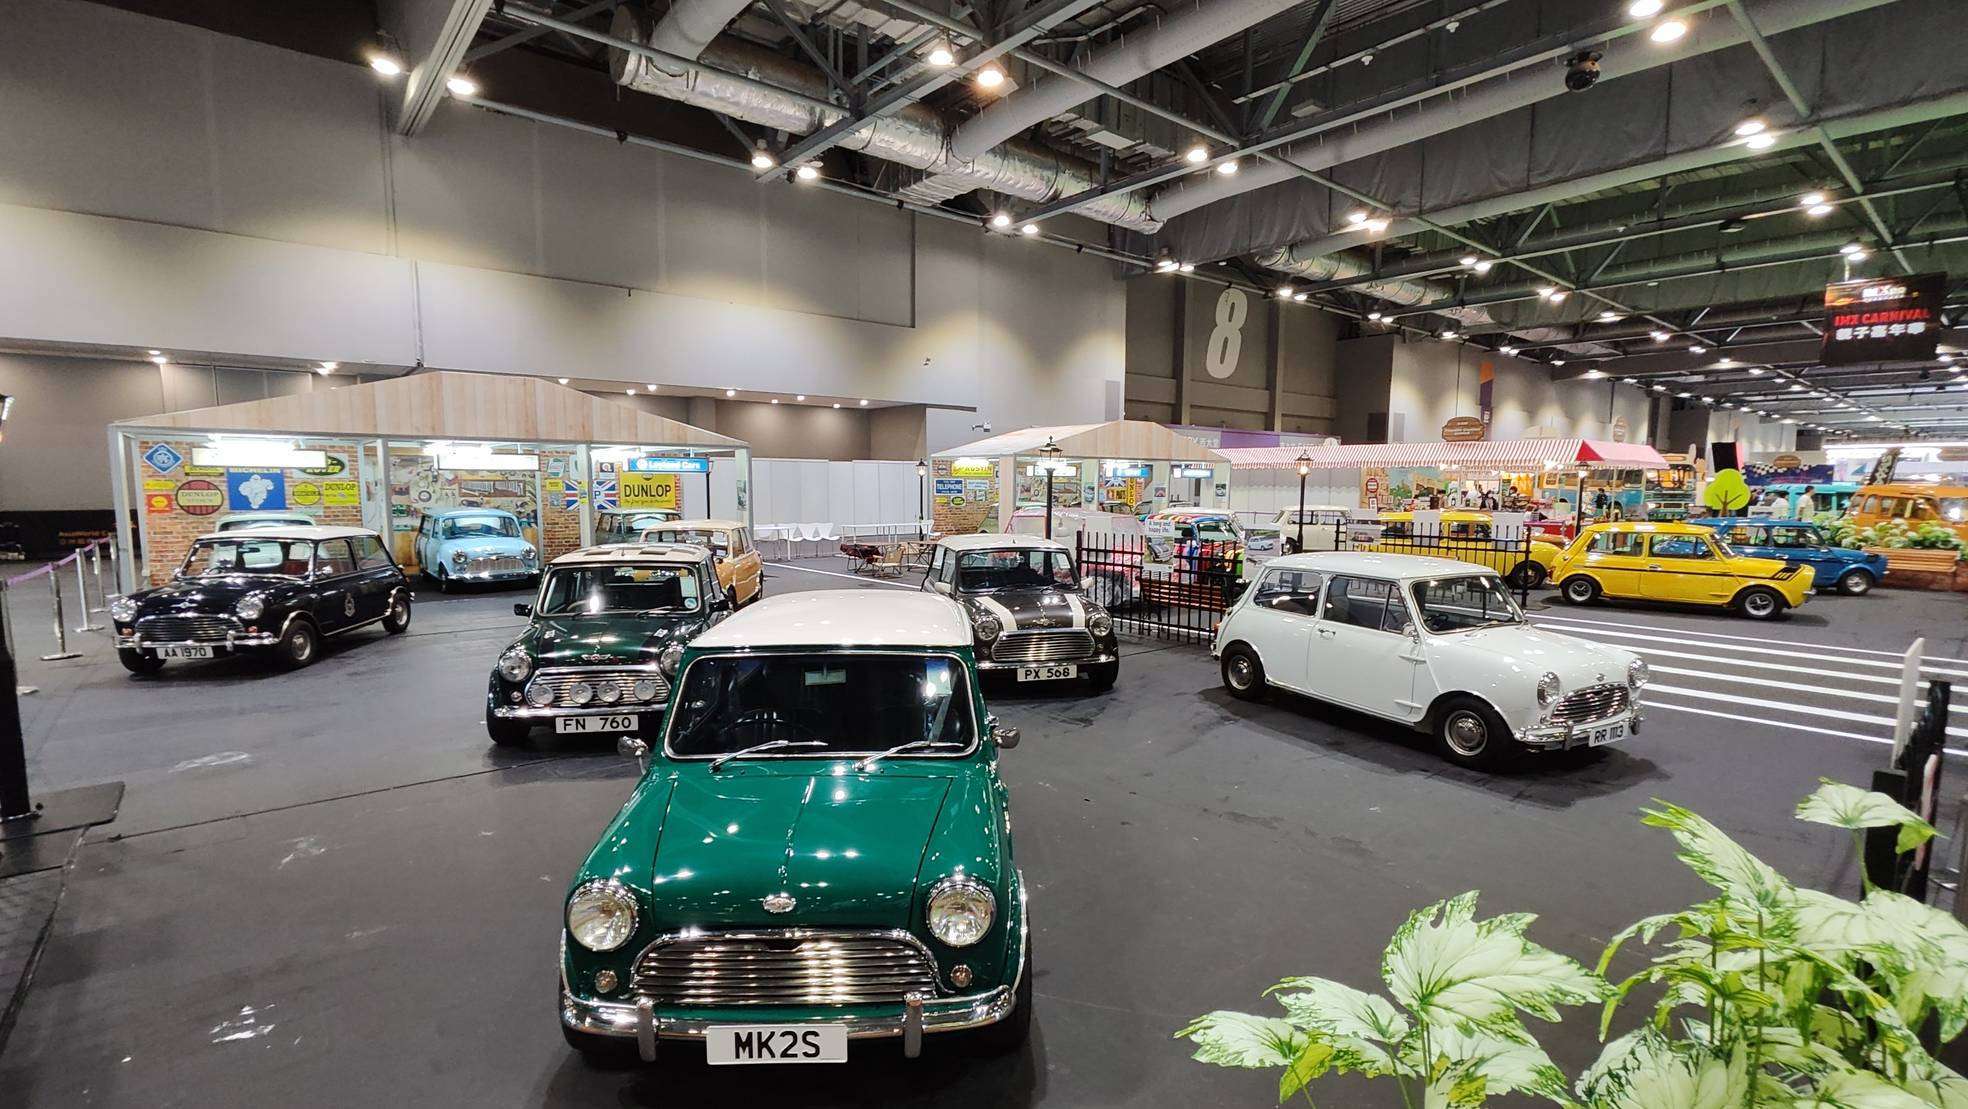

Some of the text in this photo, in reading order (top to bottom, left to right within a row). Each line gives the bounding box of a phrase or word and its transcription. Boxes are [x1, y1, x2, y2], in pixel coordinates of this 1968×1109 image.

[1834, 309, 1931, 327] IMX CARNIVAL
[1206, 288, 1248, 379] 8
[624, 484, 671, 497] DUNLOP
[164, 648, 207, 657] AA 1970
[1024, 667, 1070, 679] PX 568
[563, 717, 632, 731] FN 760
[1594, 725, 1624, 744] RR 1113
[734, 1030, 820, 1059] MK2S
